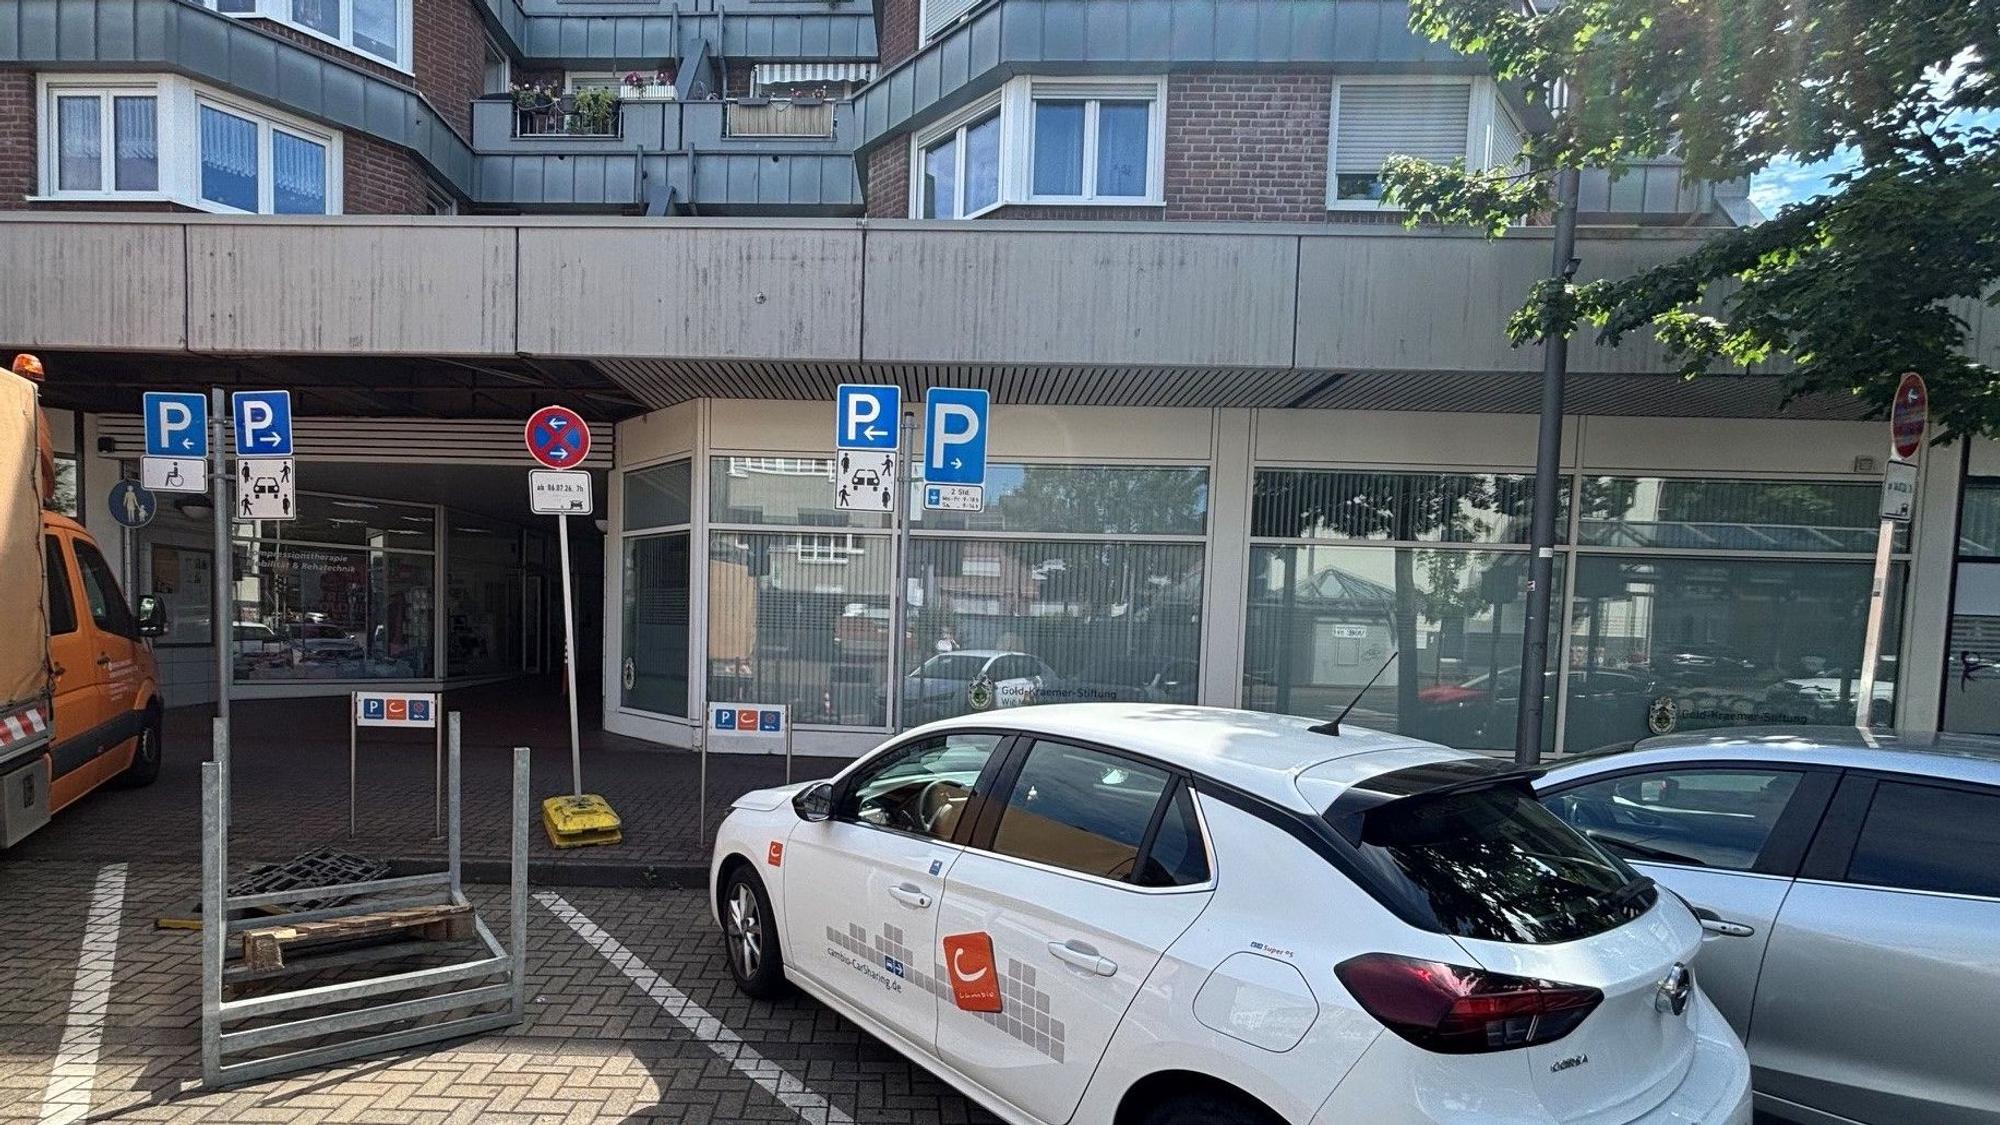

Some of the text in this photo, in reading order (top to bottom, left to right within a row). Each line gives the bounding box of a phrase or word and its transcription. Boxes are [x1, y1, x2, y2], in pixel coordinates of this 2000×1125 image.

[159, 401, 192, 448] P
[243, 400, 273, 447] P
[847, 393, 881, 440] P
[932, 403, 979, 469] P
[370, 701, 378, 713] P
[1002, 686, 1117, 699] Gold-Kraemer-Stiftung
[722, 711, 730, 723] P
[827, 946, 902, 994] cambio-CarSharing.de
